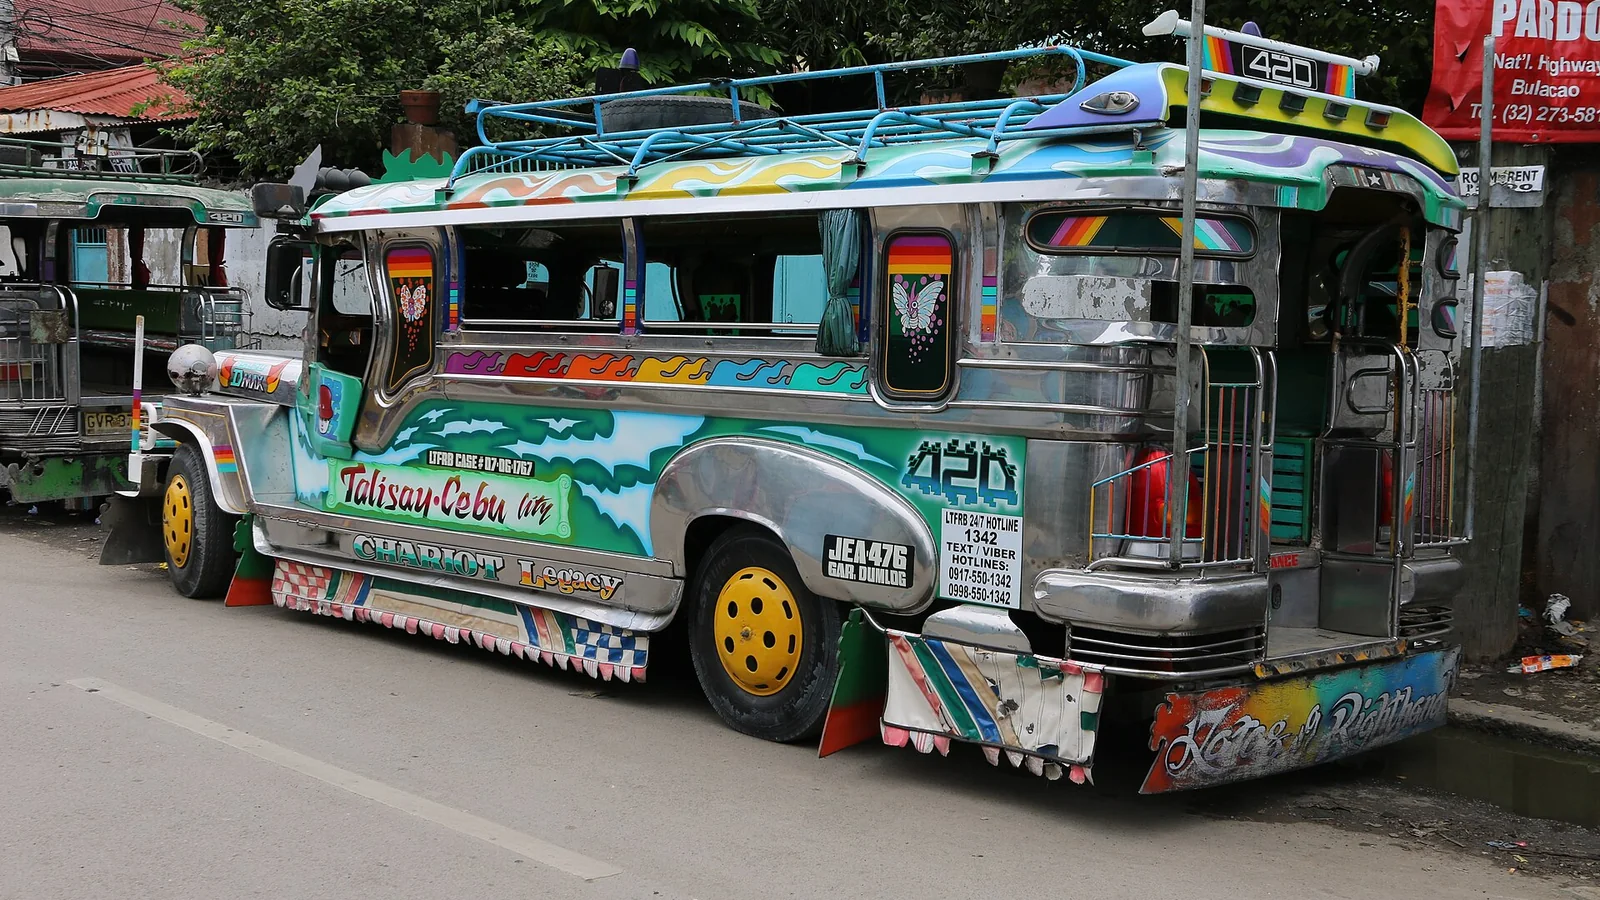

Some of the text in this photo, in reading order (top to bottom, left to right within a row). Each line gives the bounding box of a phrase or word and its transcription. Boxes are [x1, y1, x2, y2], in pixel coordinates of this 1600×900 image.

[1491, 0, 1600, 41] PARDO
[1249, 51, 1312, 87] 420
[1511, 79, 1580, 98] Bulacao
[1502, 104, 1533, 124] (32)
[1462, 172, 1497, 183] ROM
[1508, 170, 1539, 182] RENT
[209, 213, 243, 223] 420
[429, 451, 454, 466] LTFRB
[455, 453, 477, 469] CASE
[945, 511, 1019, 532] LTFRB 24/7 HOTLINE
[964, 528, 998, 545] 1342
[946, 542, 973, 554] TEXT
[983, 546, 1016, 560] VIBER
[353, 534, 623, 600] CHARIOT Legacy
[952, 554, 1009, 571] HOTLINES:
[948, 566, 1011, 588] 0917-550-1342
[948, 583, 1011, 605] 0998-550-1342
